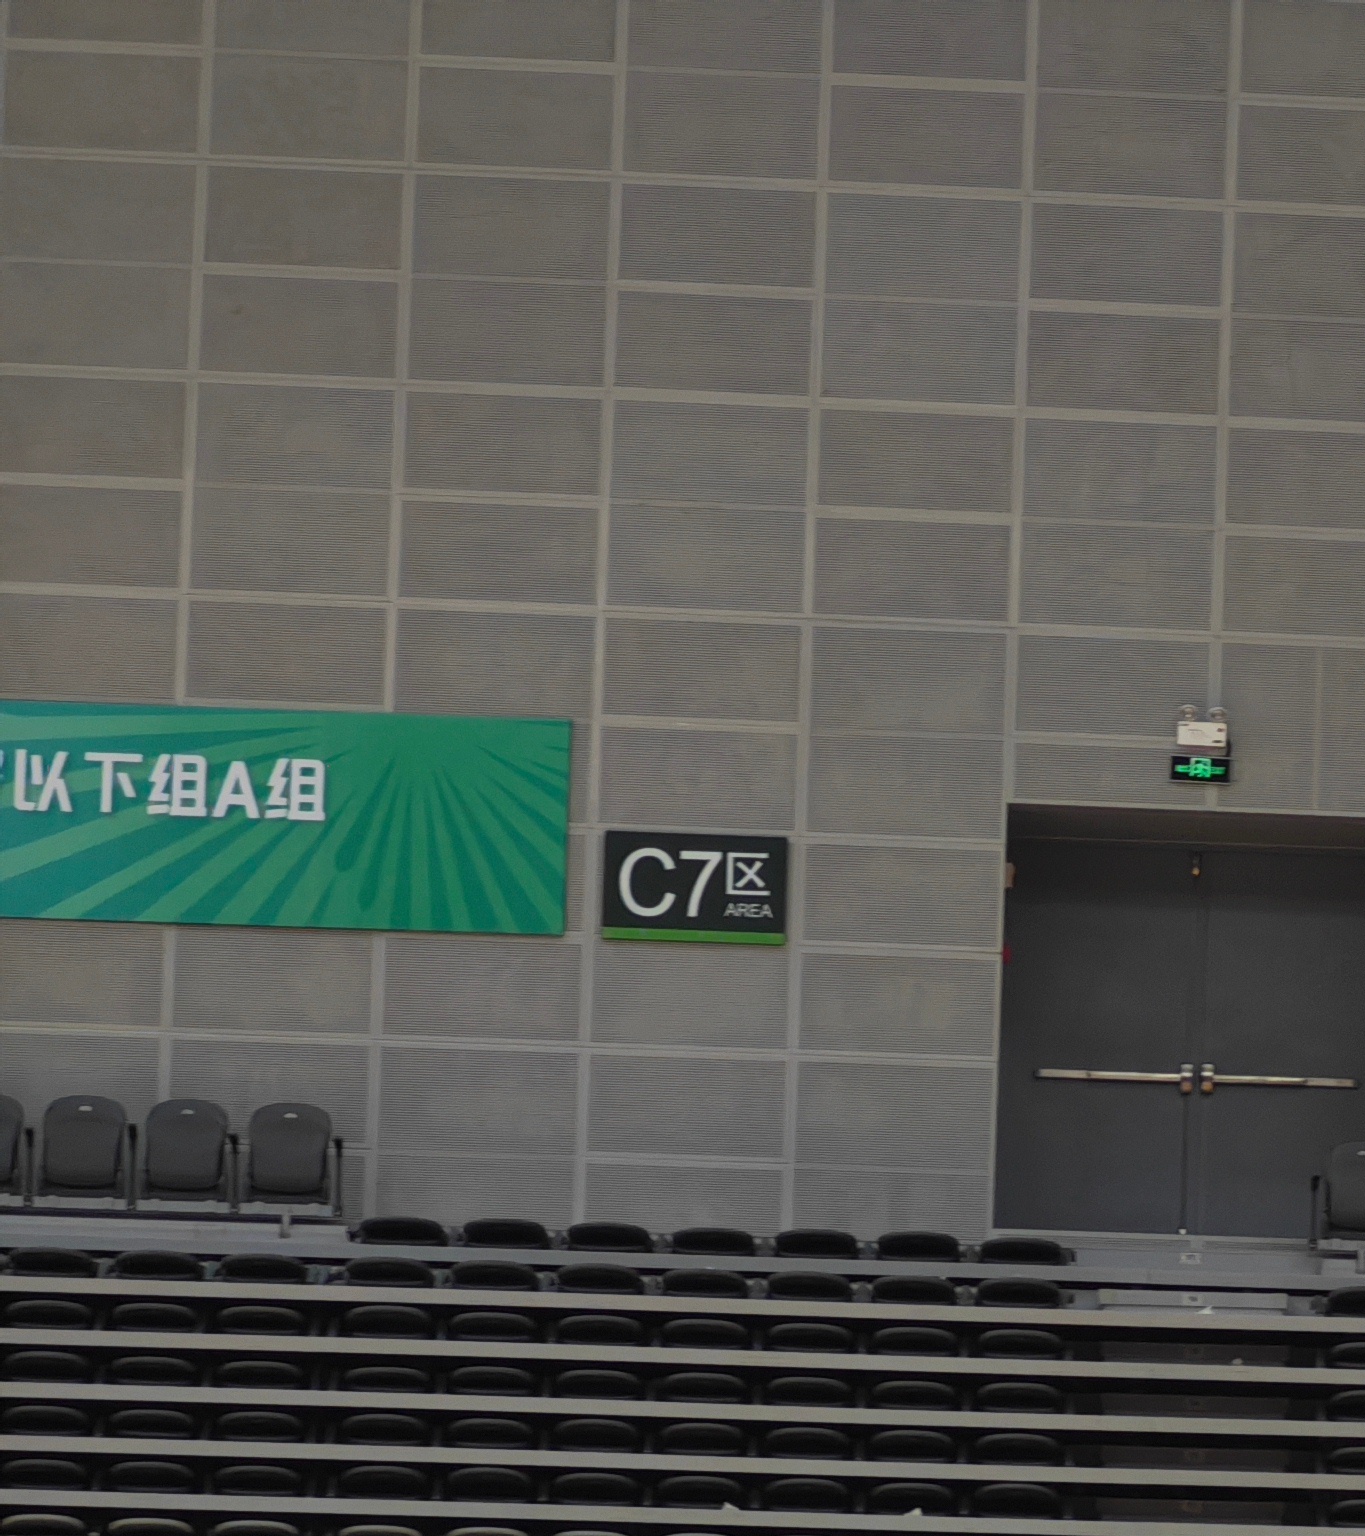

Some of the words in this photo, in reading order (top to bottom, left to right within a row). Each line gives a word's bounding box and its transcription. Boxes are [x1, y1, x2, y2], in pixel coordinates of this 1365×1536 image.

[0, 749, 326, 821] 以下组A组
[619, 847, 771, 917] C7区
[723, 903, 774, 919] AREA
